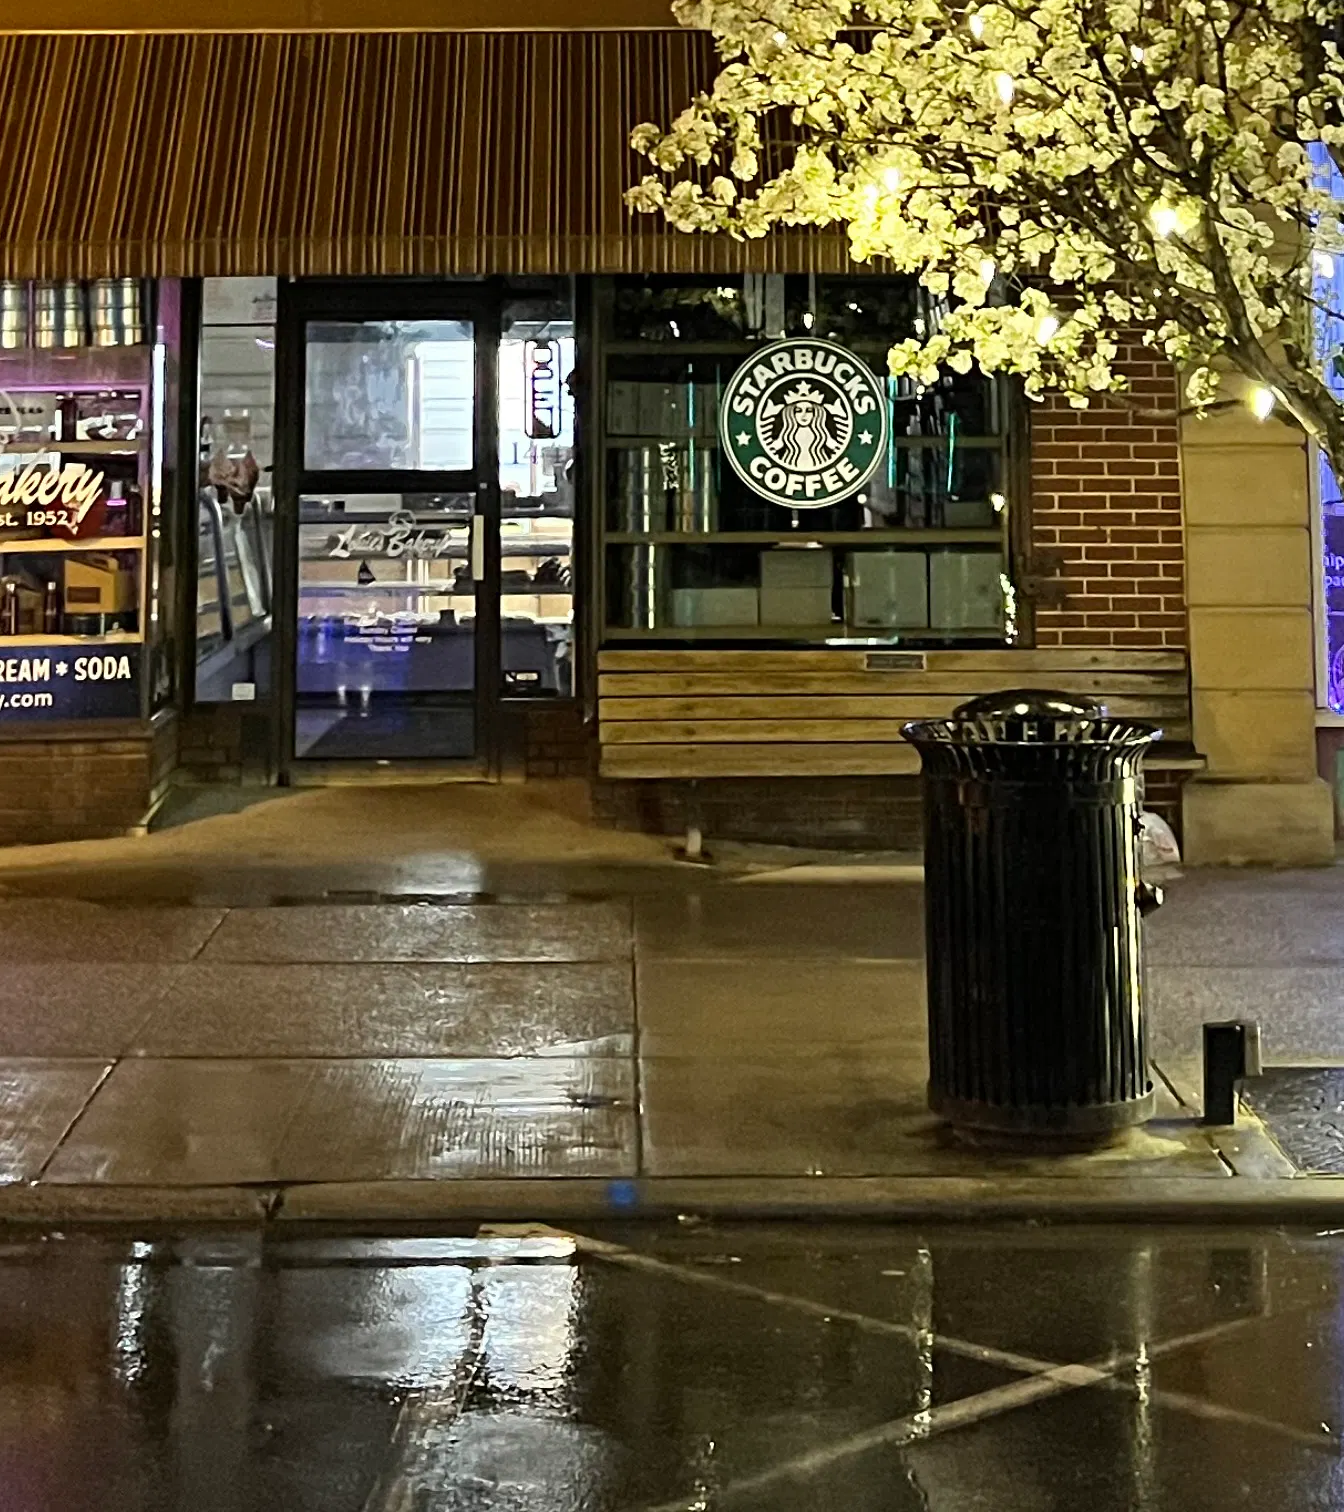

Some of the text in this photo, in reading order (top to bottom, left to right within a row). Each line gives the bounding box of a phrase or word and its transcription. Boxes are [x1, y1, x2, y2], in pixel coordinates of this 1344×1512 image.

[732, 349, 876, 416] STARBUCKS
[749, 456, 860, 497] COFFEE
[27, 511, 68, 526] 1952
[74, 656, 132, 681] SODA
